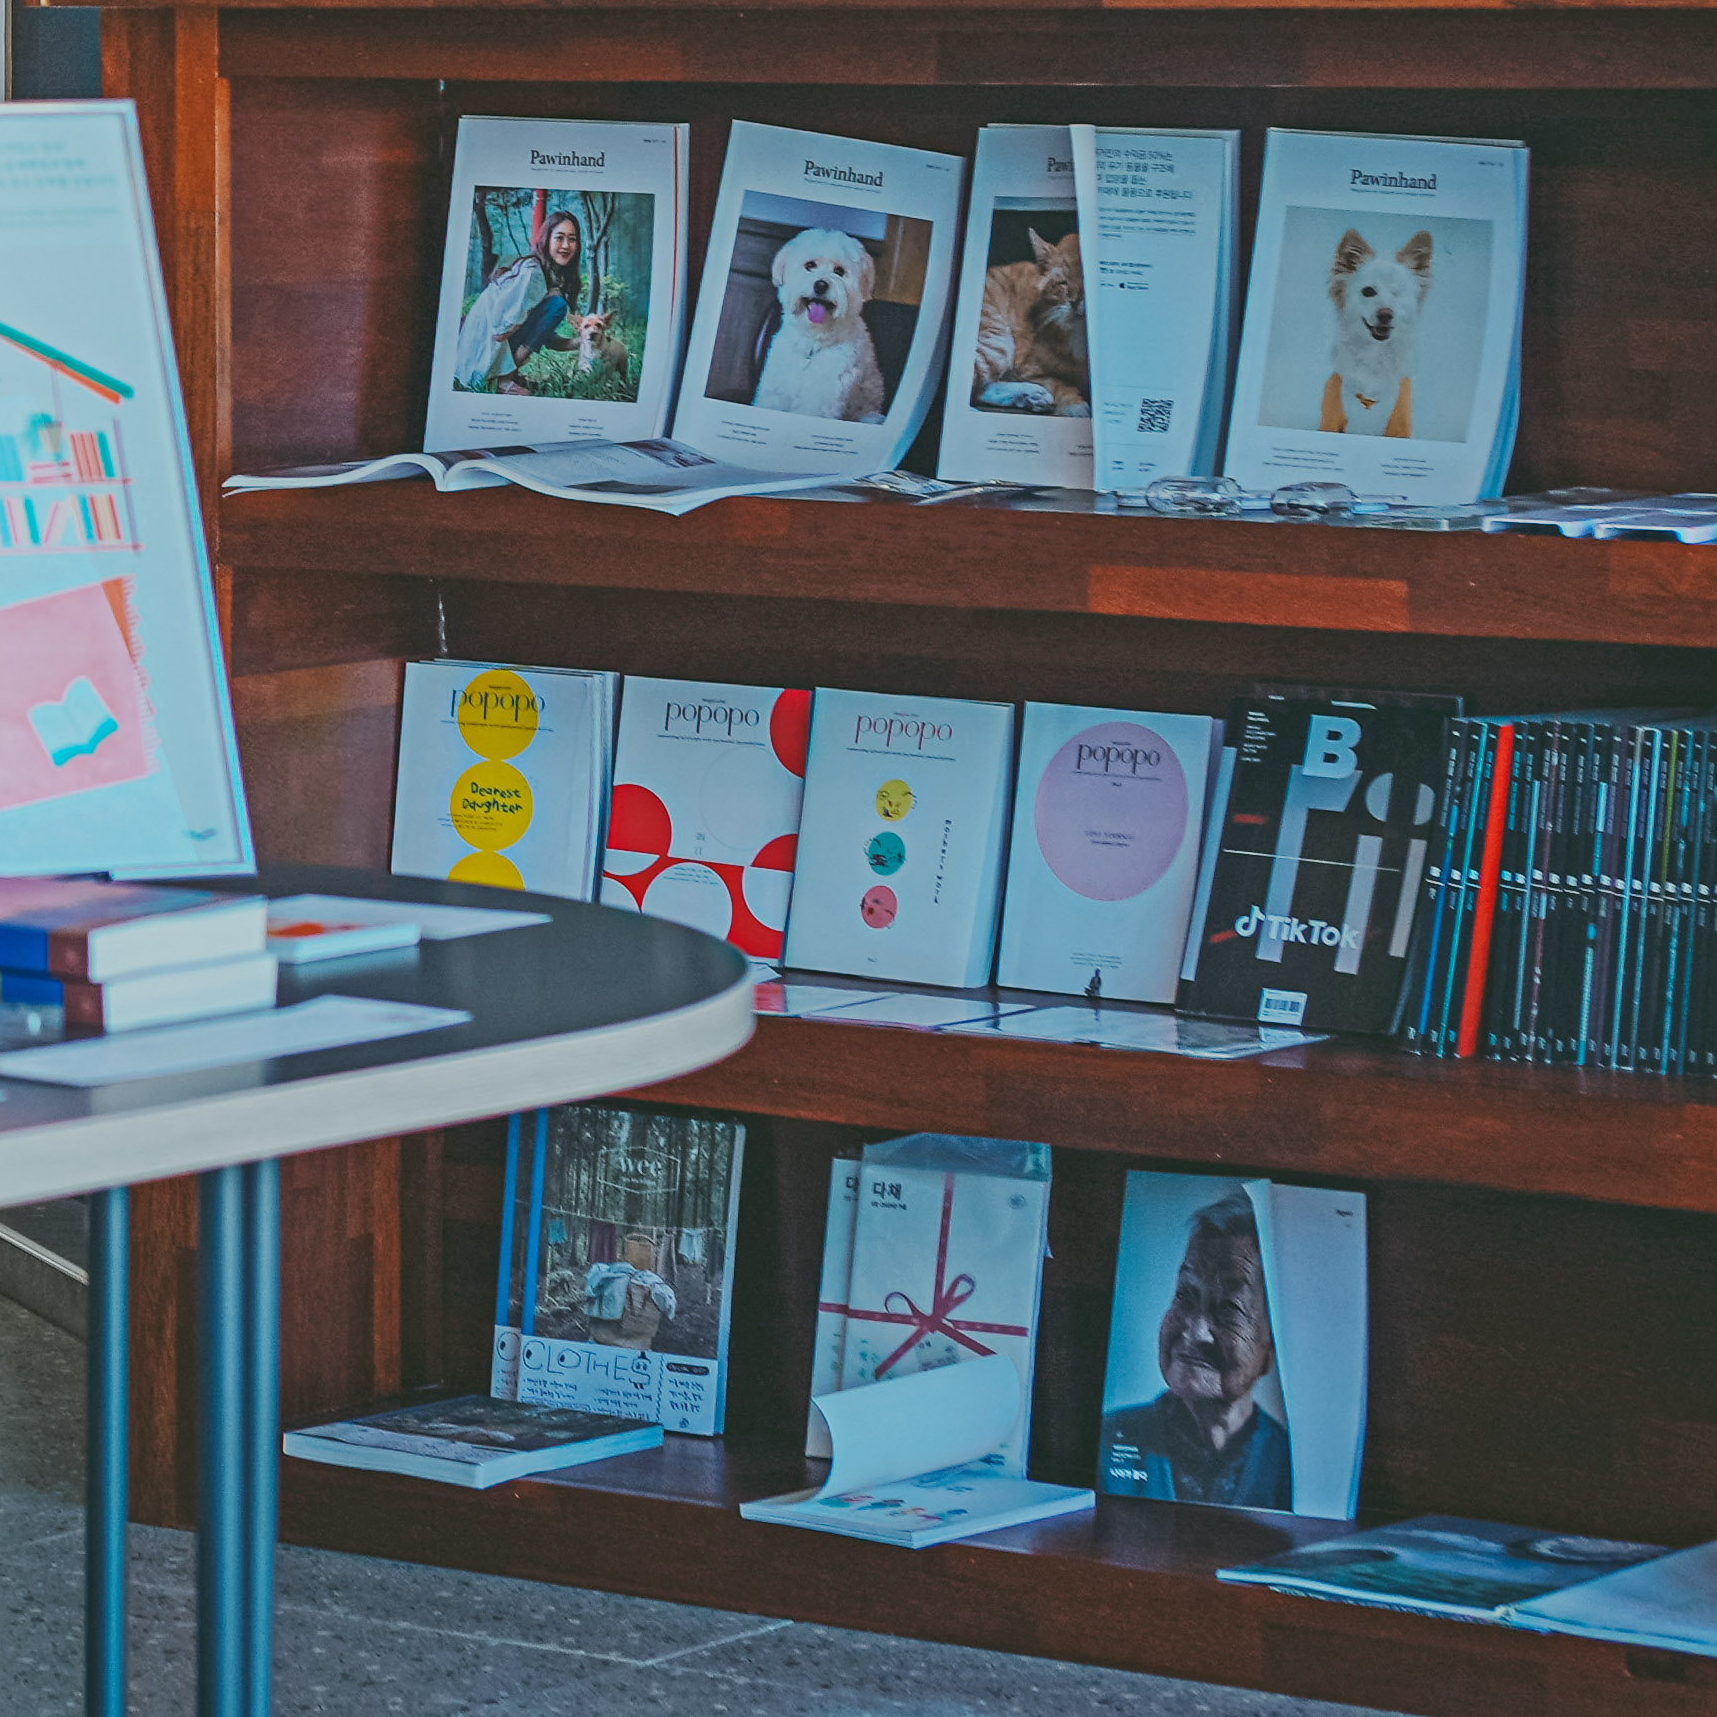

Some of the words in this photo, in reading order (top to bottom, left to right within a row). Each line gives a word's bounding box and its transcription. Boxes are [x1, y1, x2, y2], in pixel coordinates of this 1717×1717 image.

[530, 149, 606, 168] Pawinhand
[804, 159, 885, 187] Pawinhand
[1350, 168, 1438, 190] Pawinhand
[450, 689, 546, 723] popopo
[665, 702, 760, 736] popopo
[855, 715, 953, 750] popopo
[1302, 714, 1362, 779] B
[1076, 744, 1161, 775] popopo
[462, 798, 523, 814] Daughter
[470, 782, 521, 798] Dearest
[1267, 914, 1359, 950] TikTok
[522, 1339, 653, 1387] CLOTHES
